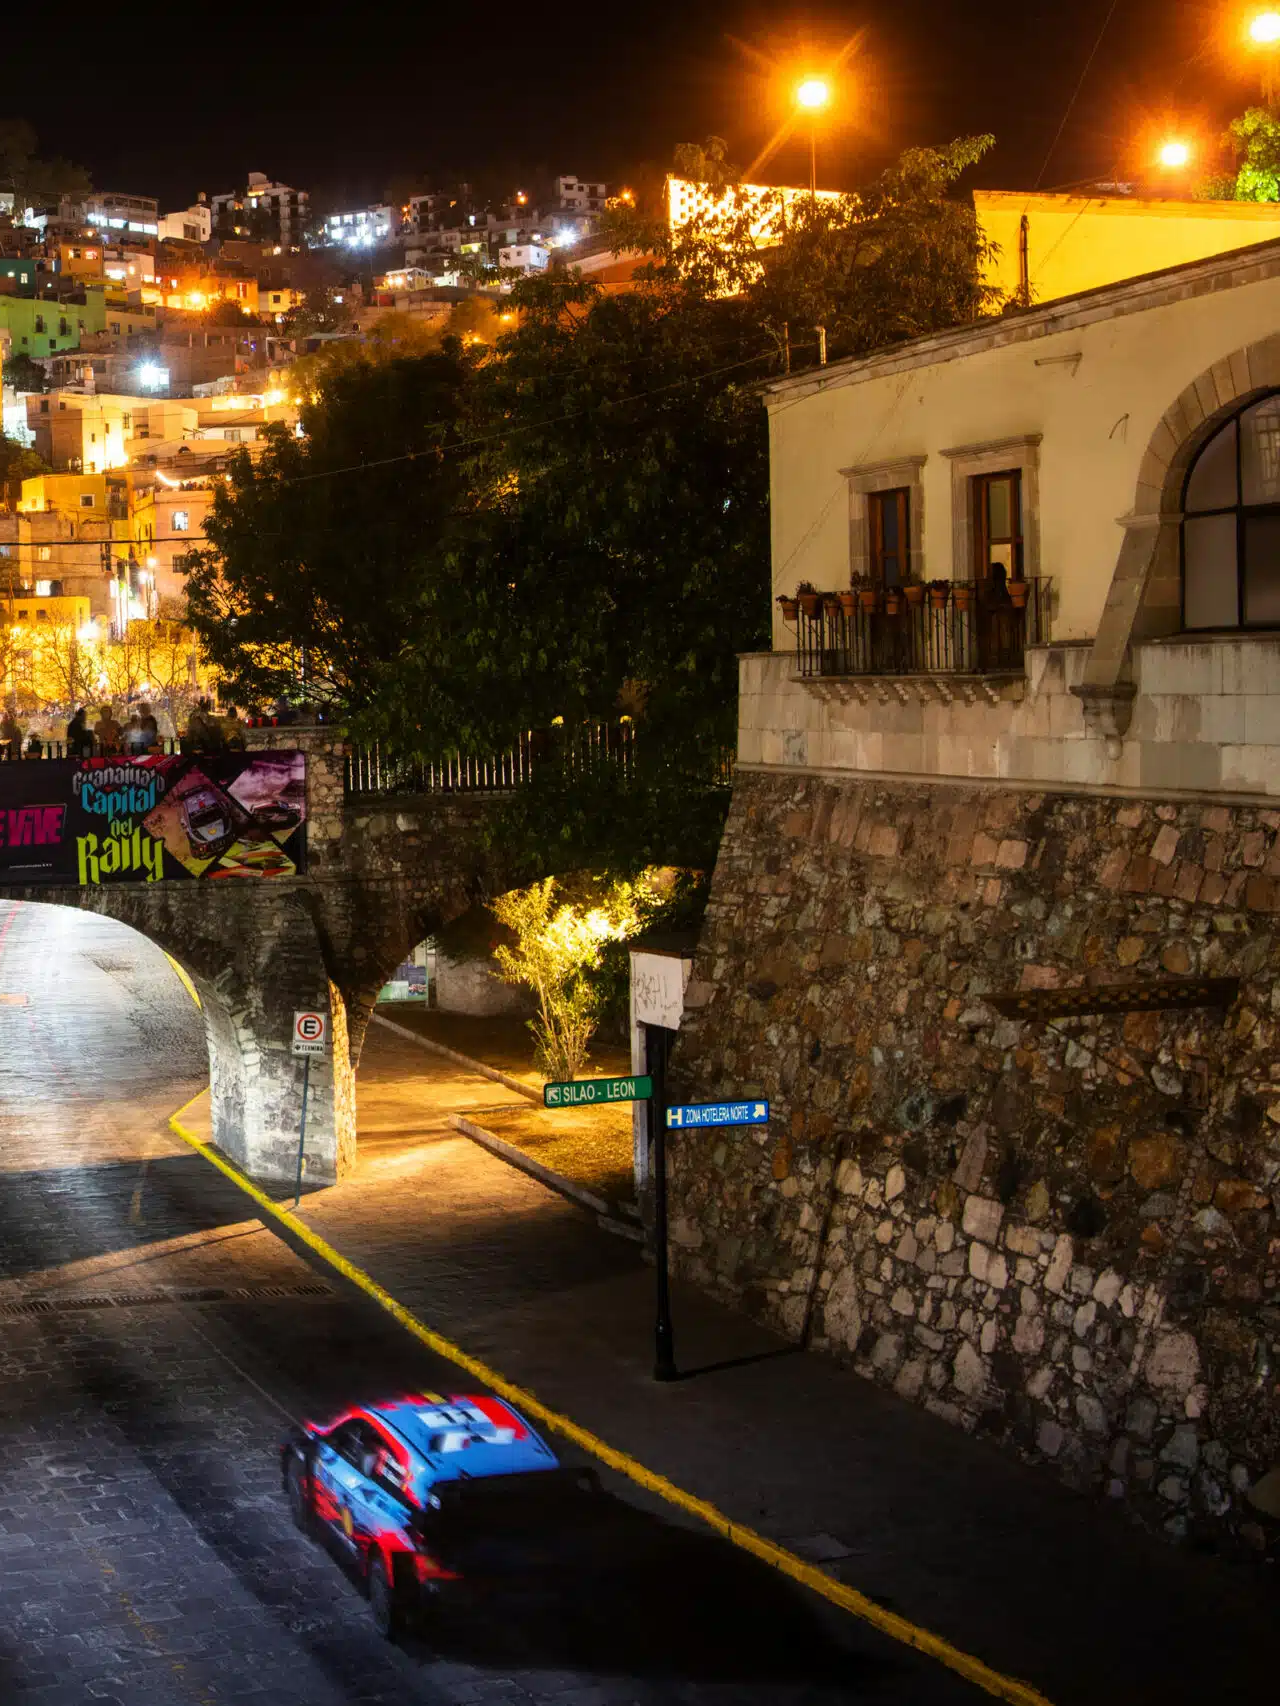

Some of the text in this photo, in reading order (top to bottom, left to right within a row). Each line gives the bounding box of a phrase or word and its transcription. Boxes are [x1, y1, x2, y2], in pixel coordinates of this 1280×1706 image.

[81, 778, 157, 823] Capital
[110, 816, 132, 837] del
[76, 825, 165, 886] Rally
[303, 1020, 317, 1034] E
[563, 1084, 595, 1102] SILAO
[606, 1081, 636, 1099] LEON
[685, 1108, 701, 1124] ZONA
[701, 1106, 730, 1122] HOTELERA
[730, 1105, 749, 1121] NORTE
